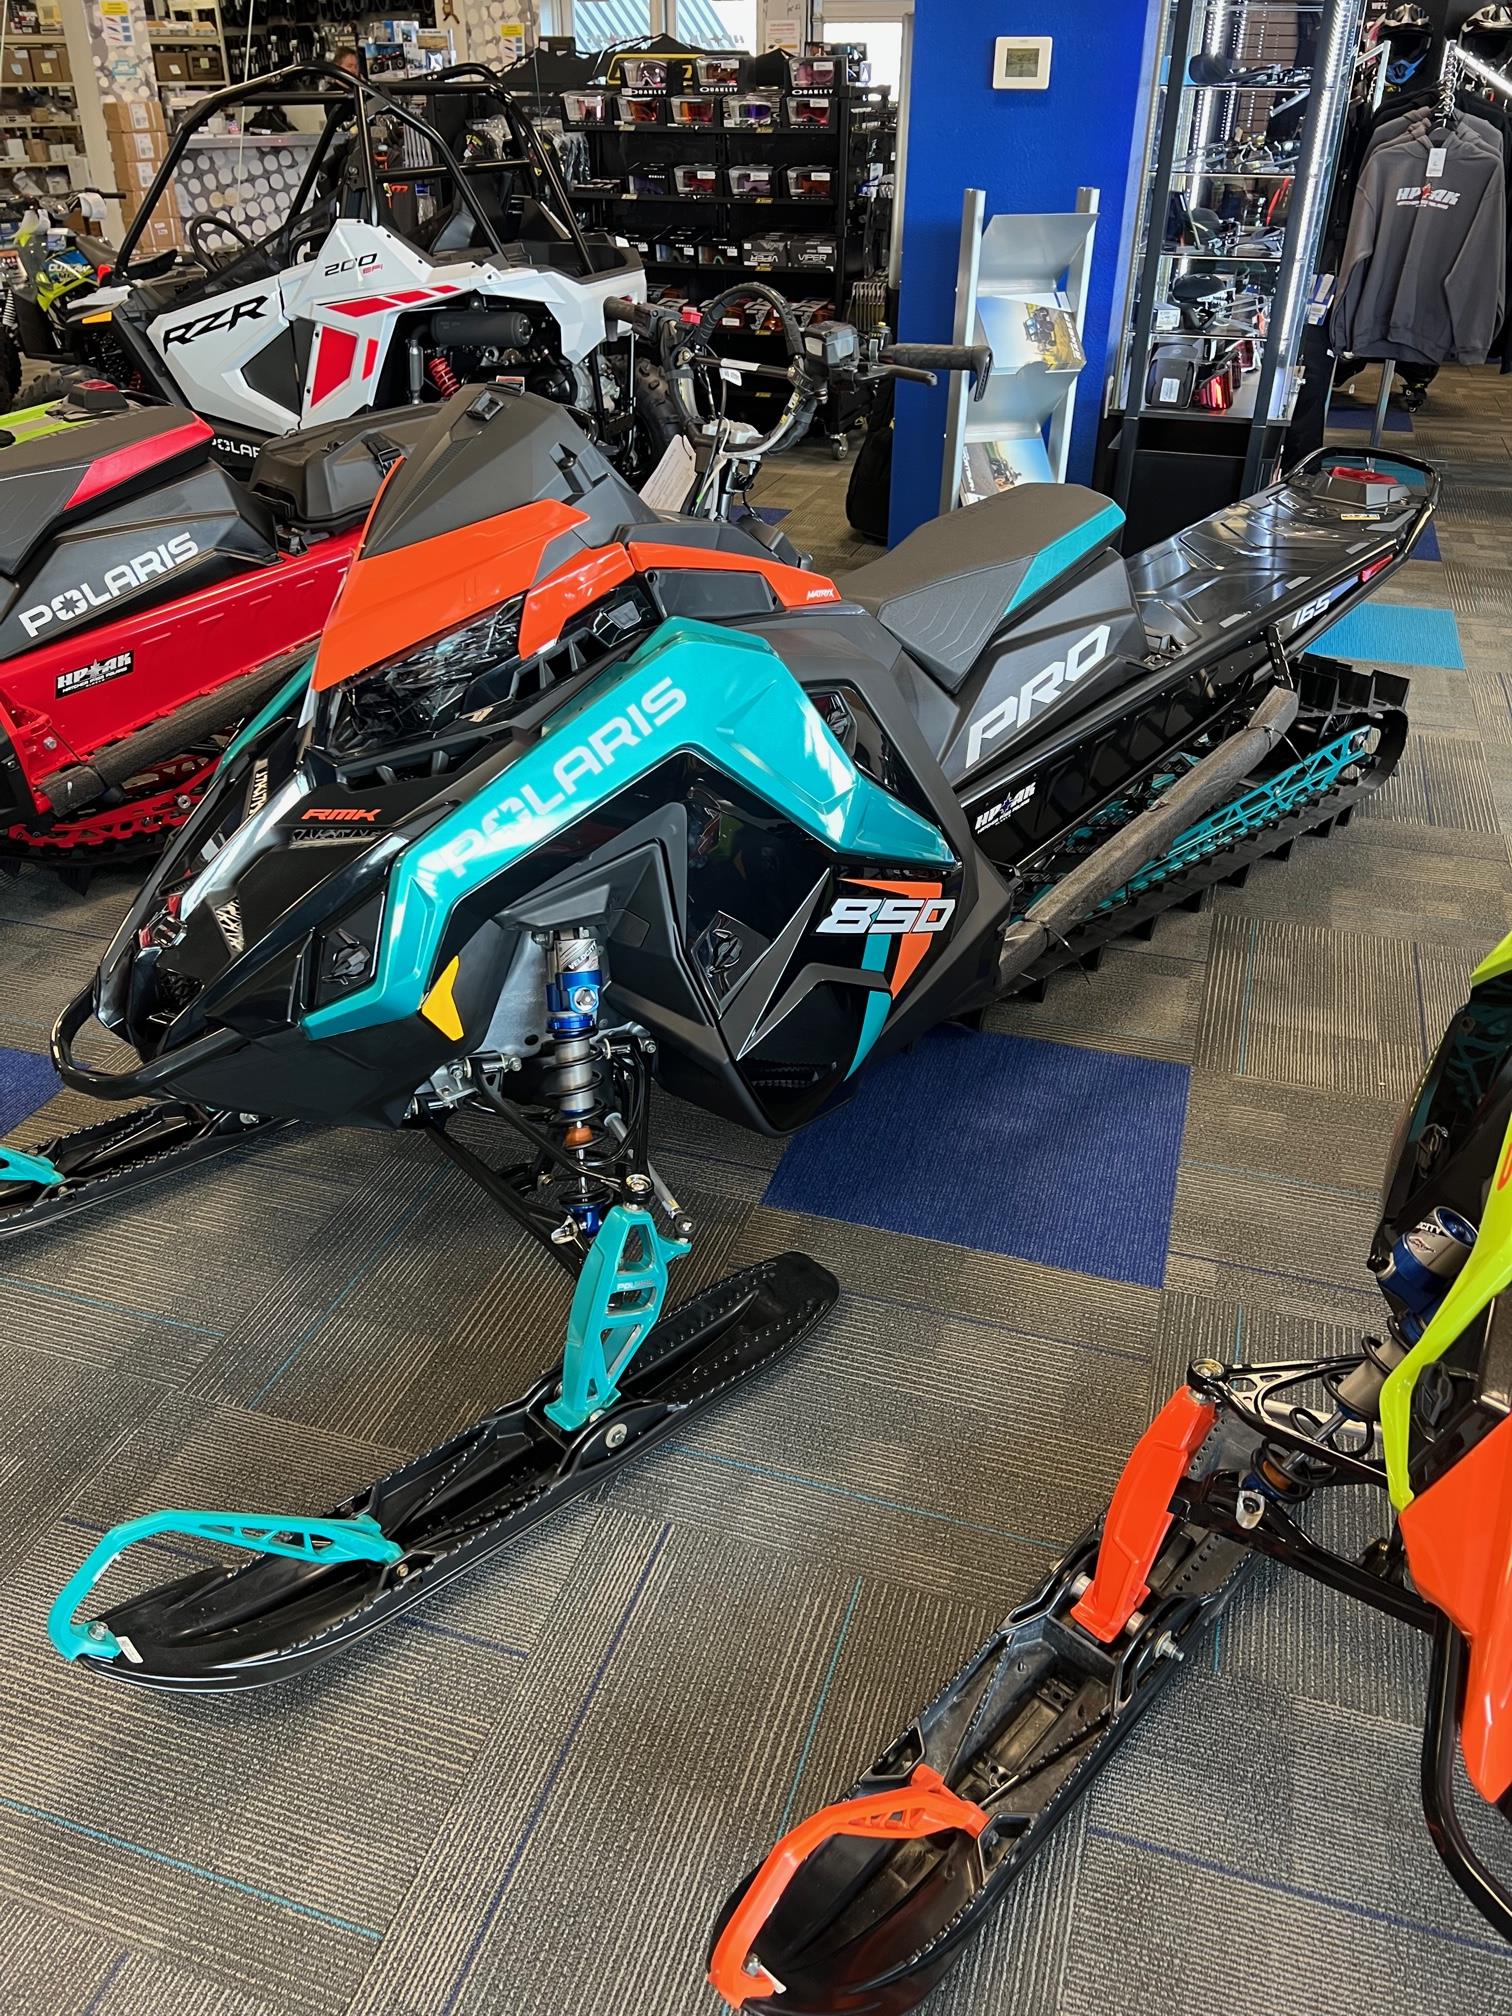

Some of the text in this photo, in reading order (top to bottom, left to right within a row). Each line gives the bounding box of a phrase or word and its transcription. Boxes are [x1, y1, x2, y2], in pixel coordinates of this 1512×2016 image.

[325, 253, 378, 277] 200
[798, 254, 828, 262] VIPER
[163, 295, 269, 354] RZR
[18, 532, 199, 637] POLARIS
[1292, 592, 1332, 630] 165
[966, 625, 1111, 768] PRO
[439, 676, 687, 878] POLARIS
[301, 808, 382, 821] RMK
[816, 898, 956, 934] 850
